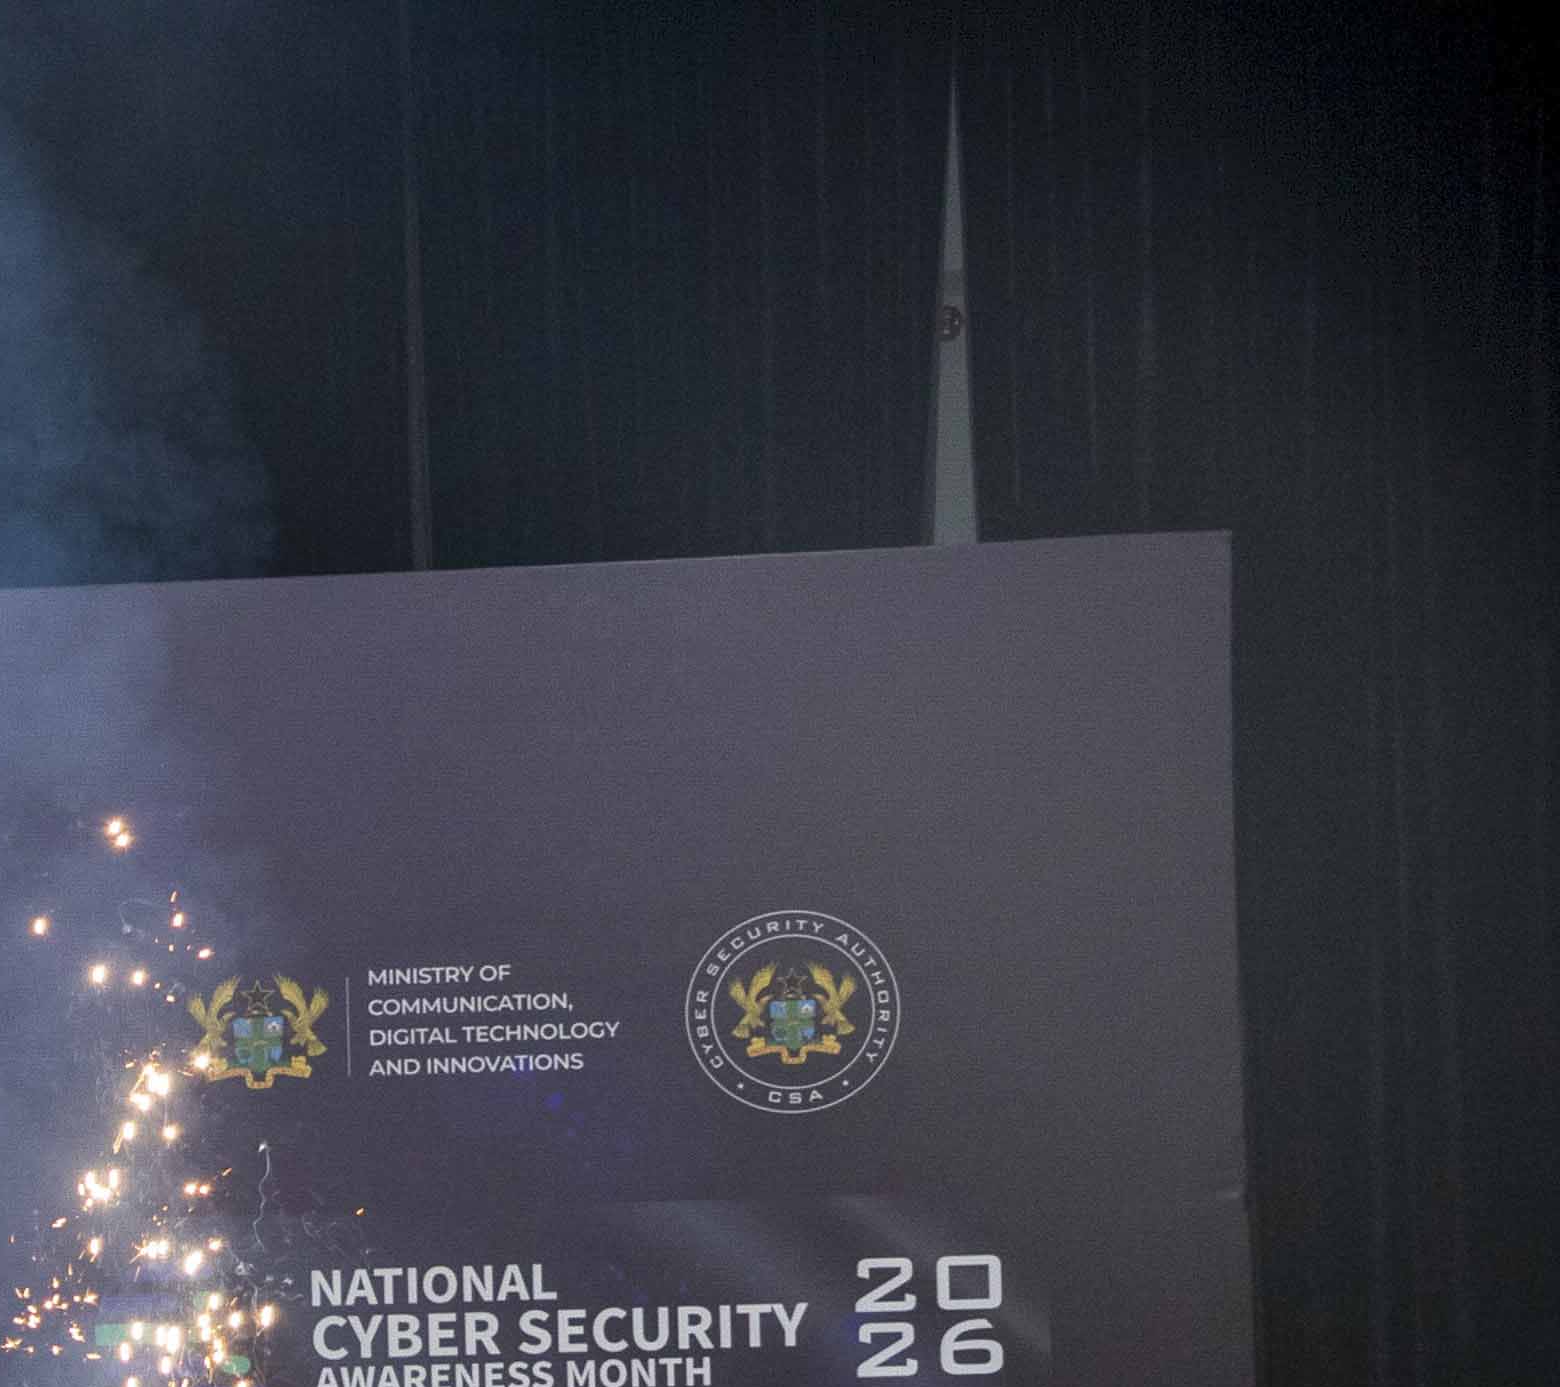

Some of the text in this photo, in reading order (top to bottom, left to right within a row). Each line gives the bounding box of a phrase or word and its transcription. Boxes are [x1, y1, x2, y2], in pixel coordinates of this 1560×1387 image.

[368, 964, 512, 986] MINISTRY OF
[368, 992, 574, 1016] COMMUNICATION,
[694, 919, 891, 1069] CYBER SECURITY AUTHORITY
[369, 1021, 620, 1046] DIGITAL TECHNOLOGY
[369, 1053, 585, 1077] AND INNOVATIONS
[768, 1089, 824, 1105] CSA
[310, 1263, 558, 1307] NATIONAL
[854, 1253, 1003, 1314] 20
[311, 1302, 809, 1361] CYBER SECURITY
[856, 1317, 1005, 1379] 26
